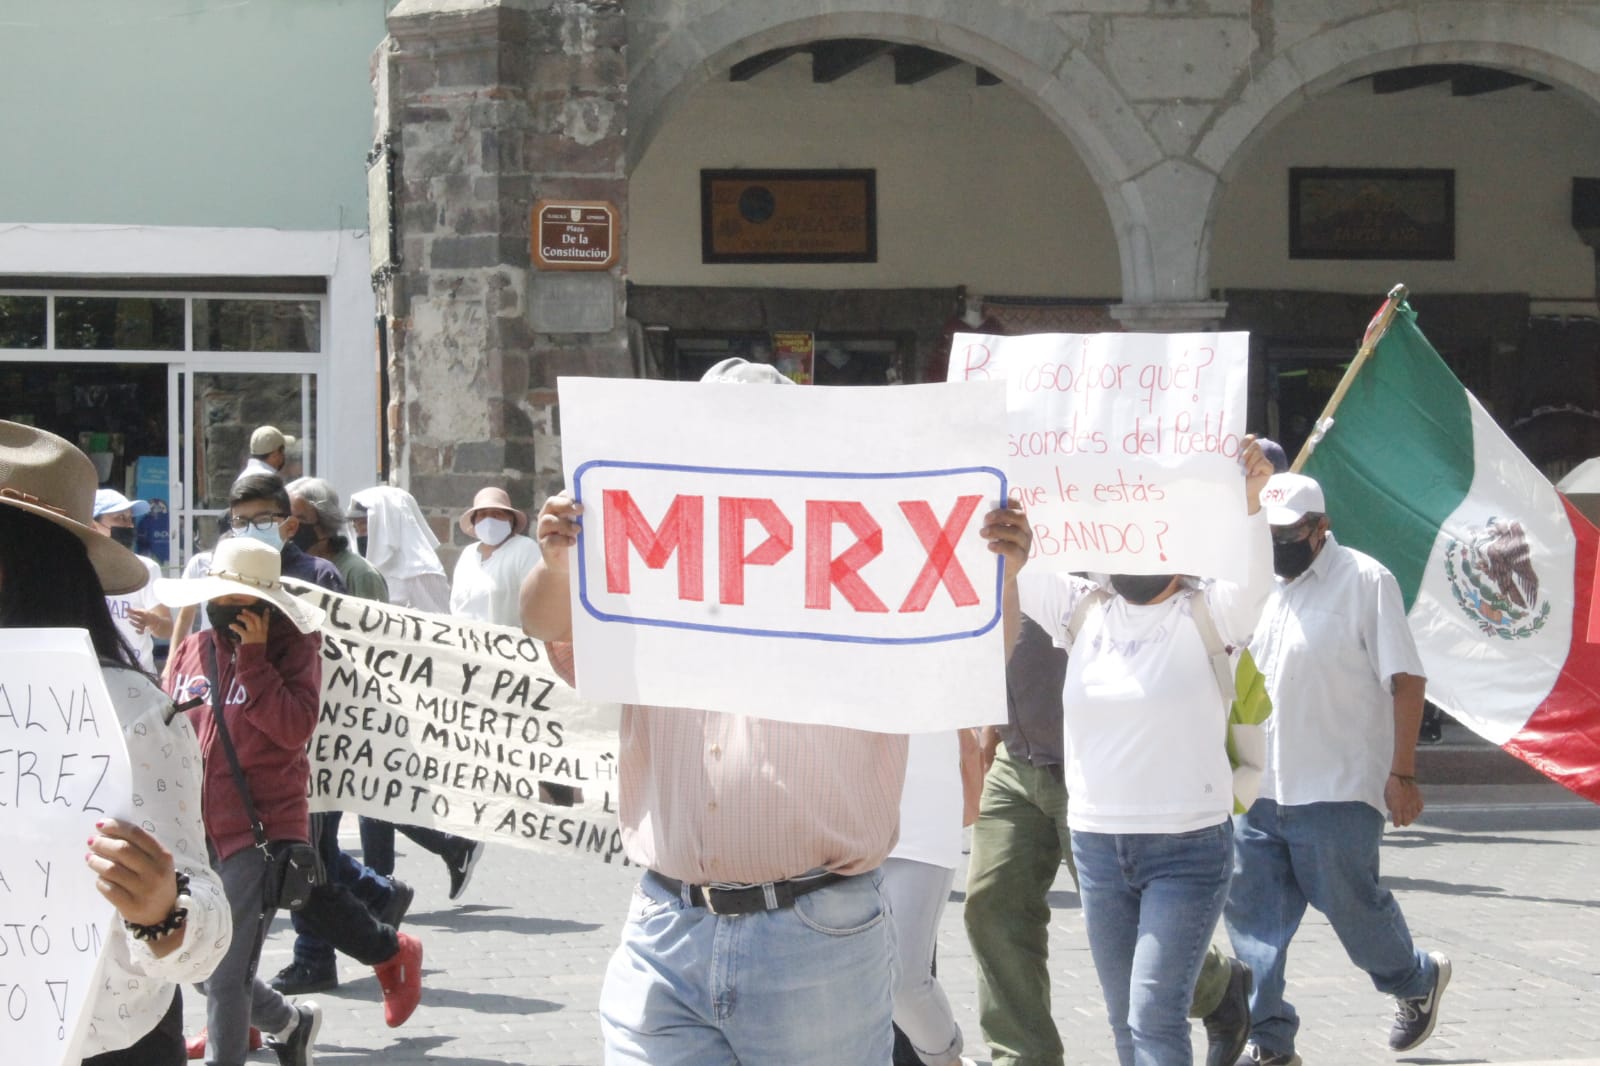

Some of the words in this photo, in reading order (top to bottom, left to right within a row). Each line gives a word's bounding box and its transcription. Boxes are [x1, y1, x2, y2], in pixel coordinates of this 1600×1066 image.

[543, 246, 607, 258] Constitución
[562, 234, 577, 244] De
[579, 234, 589, 245] la
[566, 225, 585, 233] Plaza
[1139, 347, 1214, 414] qué?
[1123, 416, 1162, 455] del
[1009, 485, 1047, 515] que
[1056, 465, 1079, 502] le
[1094, 468, 1166, 503] estás
[602, 489, 984, 614] MPRX
[1019, 520, 1168, 562] BANDO?
[323, 635, 433, 687] STICIA
[462, 663, 481, 695] Y
[491, 670, 556, 712] PAZ
[327, 665, 402, 704] MAS
[416, 693, 563, 748] MUERTOS
[320, 701, 409, 738] NSEJO
[421, 722, 589, 781] MUNICIPAL
[384, 748, 534, 800] GOBIERNO
[473, 801, 489, 825] Y
[35, 859, 50, 898] Y
